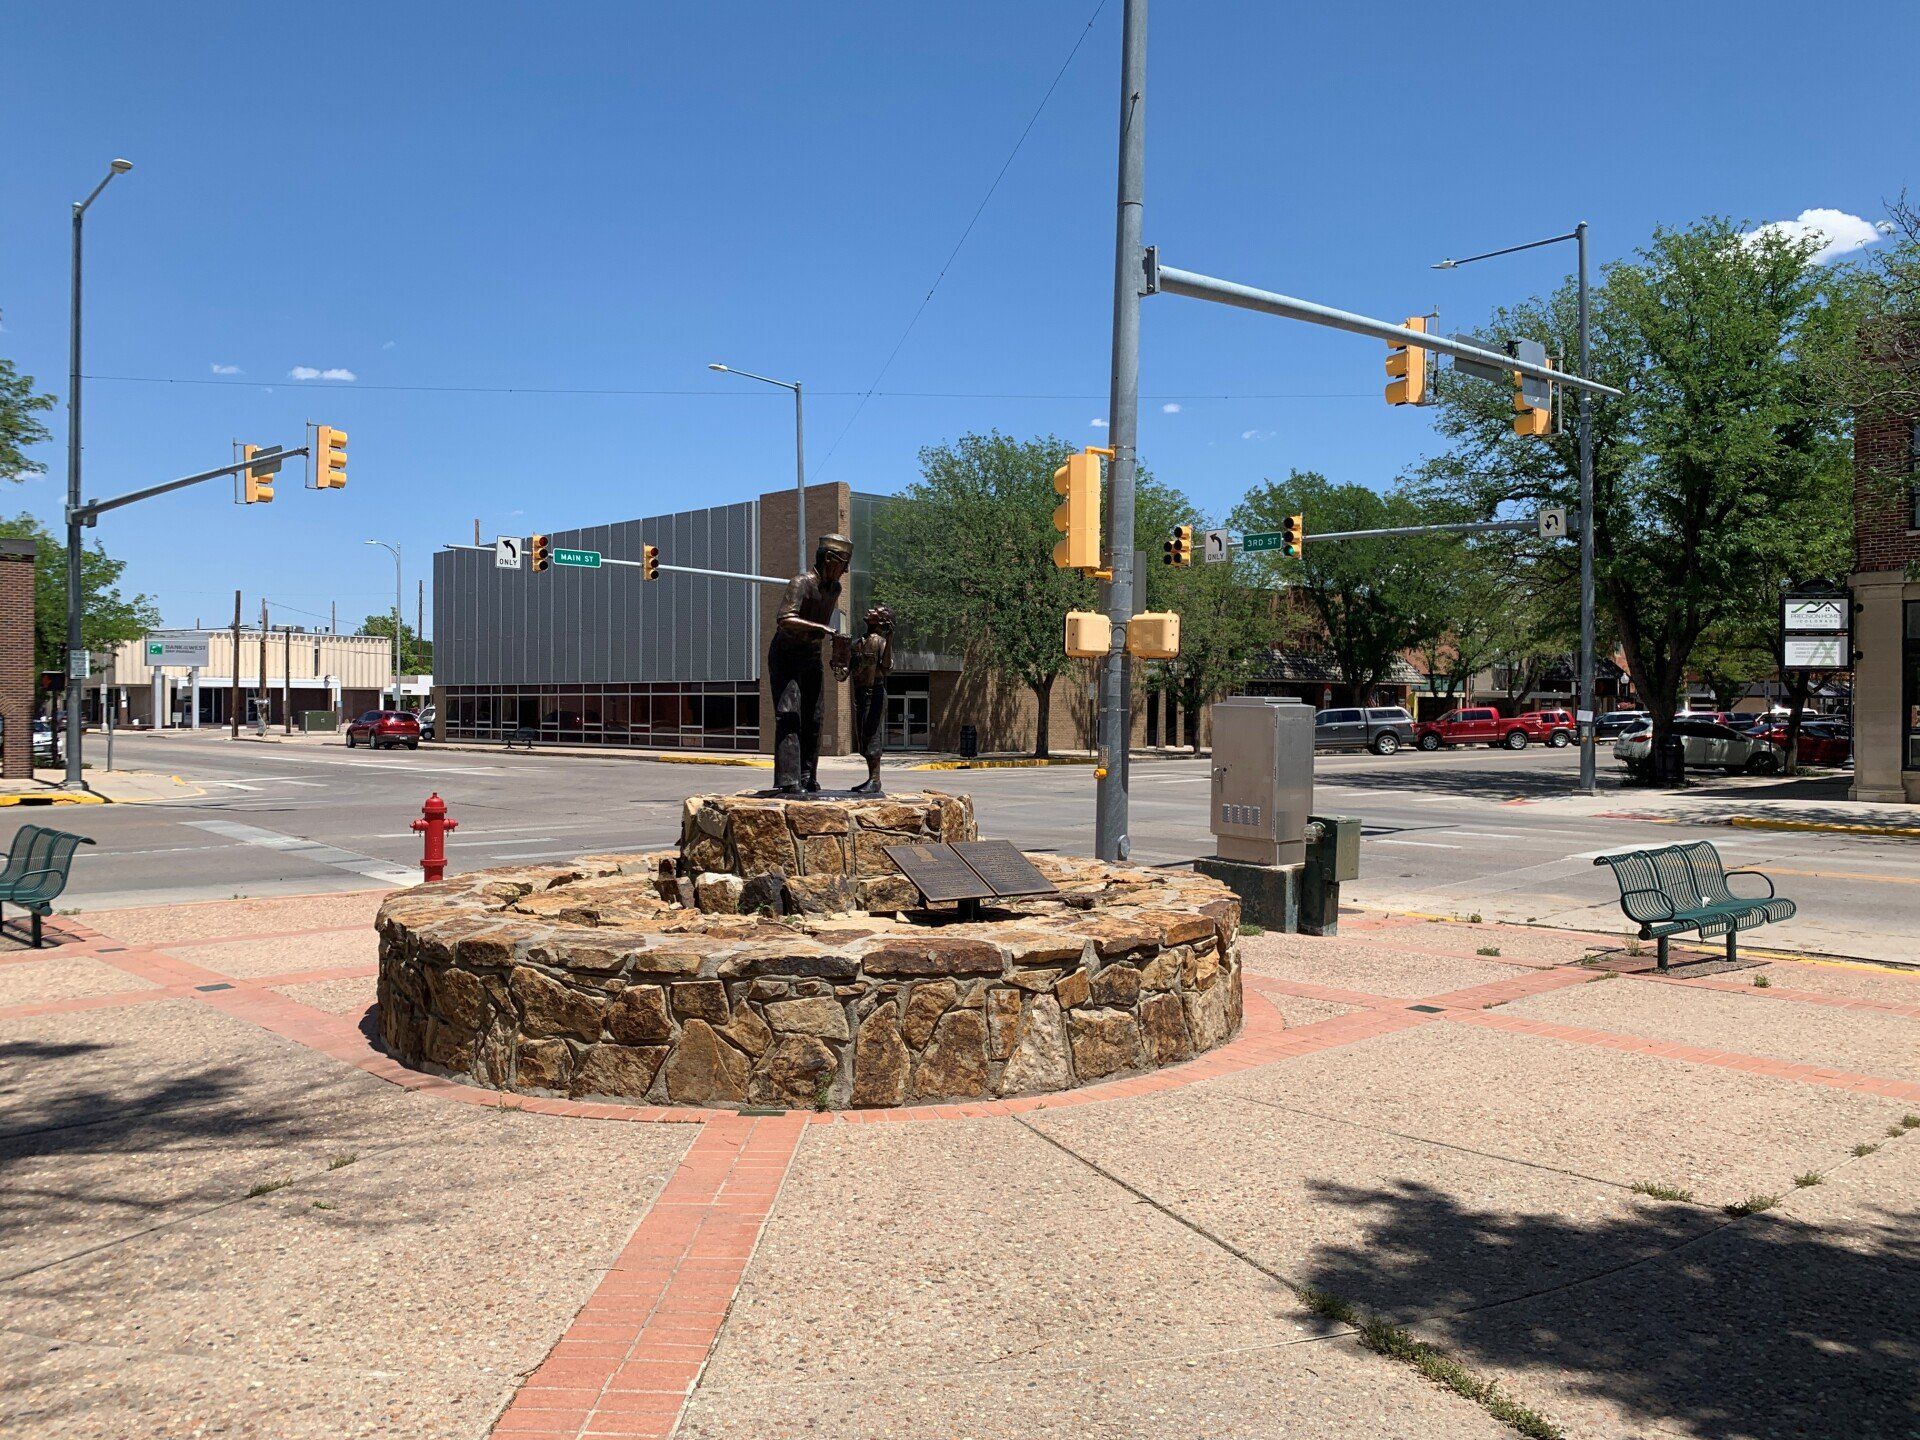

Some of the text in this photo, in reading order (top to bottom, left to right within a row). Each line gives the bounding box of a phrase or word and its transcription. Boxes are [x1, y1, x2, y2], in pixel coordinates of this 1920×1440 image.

[1247, 537, 1278, 547] 3RD ST
[560, 553, 594, 563] MAIN ST
[1207, 552, 1225, 561] ONLY
[499, 558, 518, 566] ONLY
